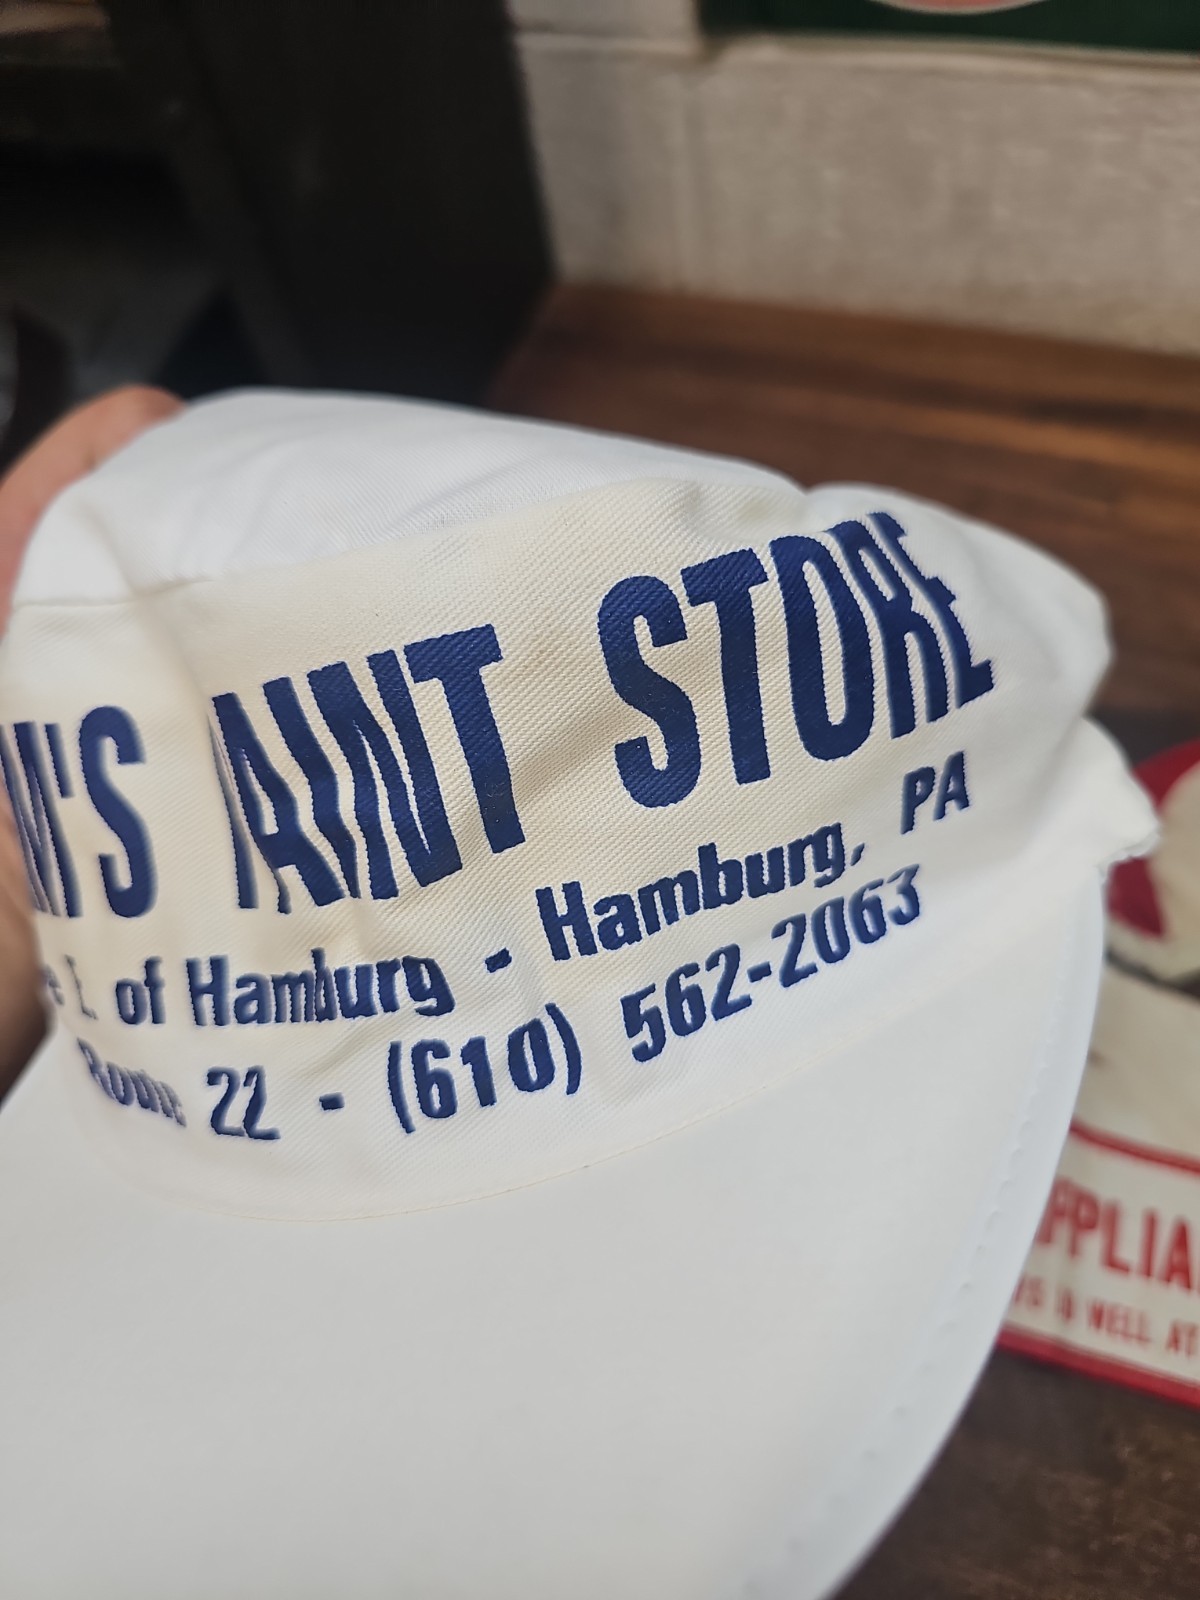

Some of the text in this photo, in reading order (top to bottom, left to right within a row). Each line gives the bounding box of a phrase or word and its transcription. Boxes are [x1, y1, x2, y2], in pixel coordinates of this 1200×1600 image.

[206, 623, 526, 914] AINT
[597, 511, 995, 808] STORE
[114, 956, 166, 1025] of
[186, 947, 456, 1027] Hamburg
[535, 822, 865, 962] Hamburg,
[901, 750, 970, 835] PA
[206, 1065, 281, 1140] 22
[387, 1003, 582, 1134] (610)
[620, 864, 920, 1063] 562-2063
[1037, 1176, 1200, 1296] PPLIA
